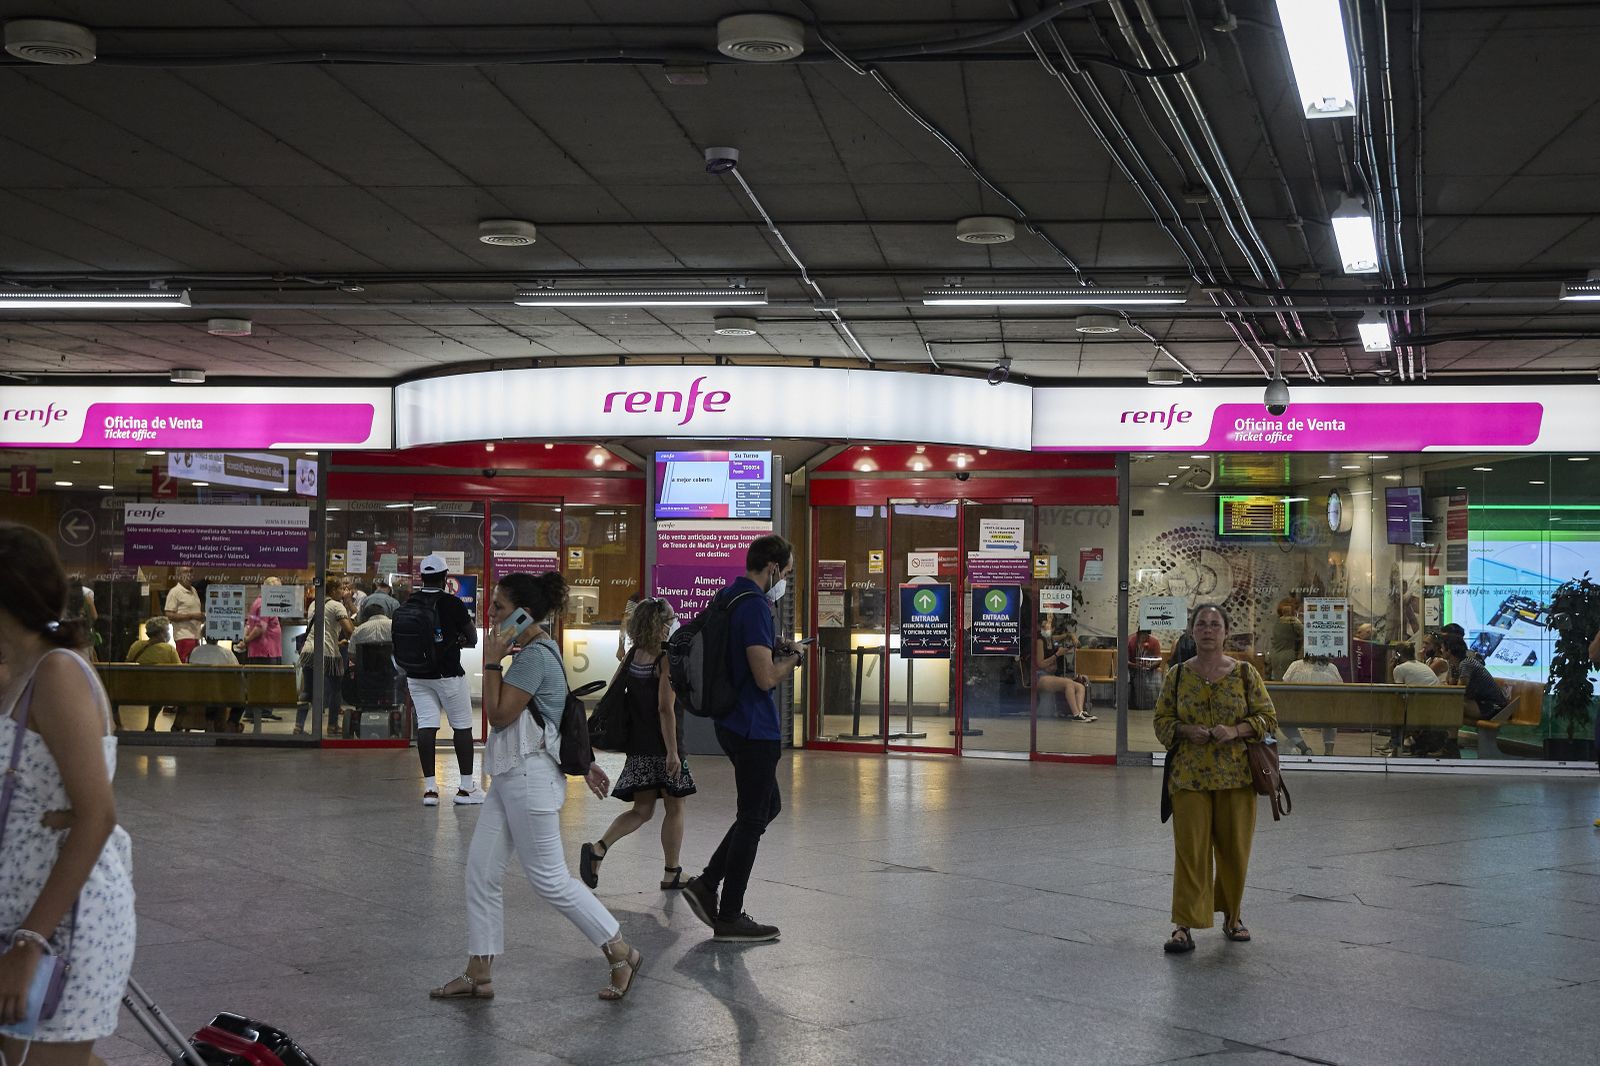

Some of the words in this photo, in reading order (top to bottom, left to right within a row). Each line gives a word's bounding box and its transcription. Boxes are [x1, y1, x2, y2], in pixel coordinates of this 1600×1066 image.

[603, 376, 731, 426] renfe
[3, 402, 68, 428] renfe
[1120, 403, 1193, 431] renfe
[104, 416, 148, 429] Oficina
[151, 416, 167, 429] de
[168, 416, 203, 430] Venta
[1234, 418, 1283, 431] Oficina
[1287, 418, 1304, 431] de
[1307, 418, 1346, 431] Venta
[104, 429, 130, 439] Ticket
[132, 429, 157, 441] office
[1234, 431, 1263, 442] Ticket
[1265, 432, 1293, 443] office
[17, 472, 30, 492] 1
[158, 471, 172, 493] 2
[126, 506, 166, 521] renfe
[688, 533, 717, 542] anticipada
[721, 542, 737, 550] Larga
[204, 572, 230, 582] renfe
[574, 576, 601, 586] renfe
[611, 577, 637, 587] renfe
[694, 576, 726, 586] Almería
[852, 579, 876, 590] renfe
[1291, 584, 1319, 596] renfe
[657, 587, 688, 596] Talavera
[1041, 592, 1071, 600] TOLEDO
[680, 599, 698, 609] Jaén
[902, 621, 924, 629] ATENCIÓN
[572, 641, 590, 673] 5
